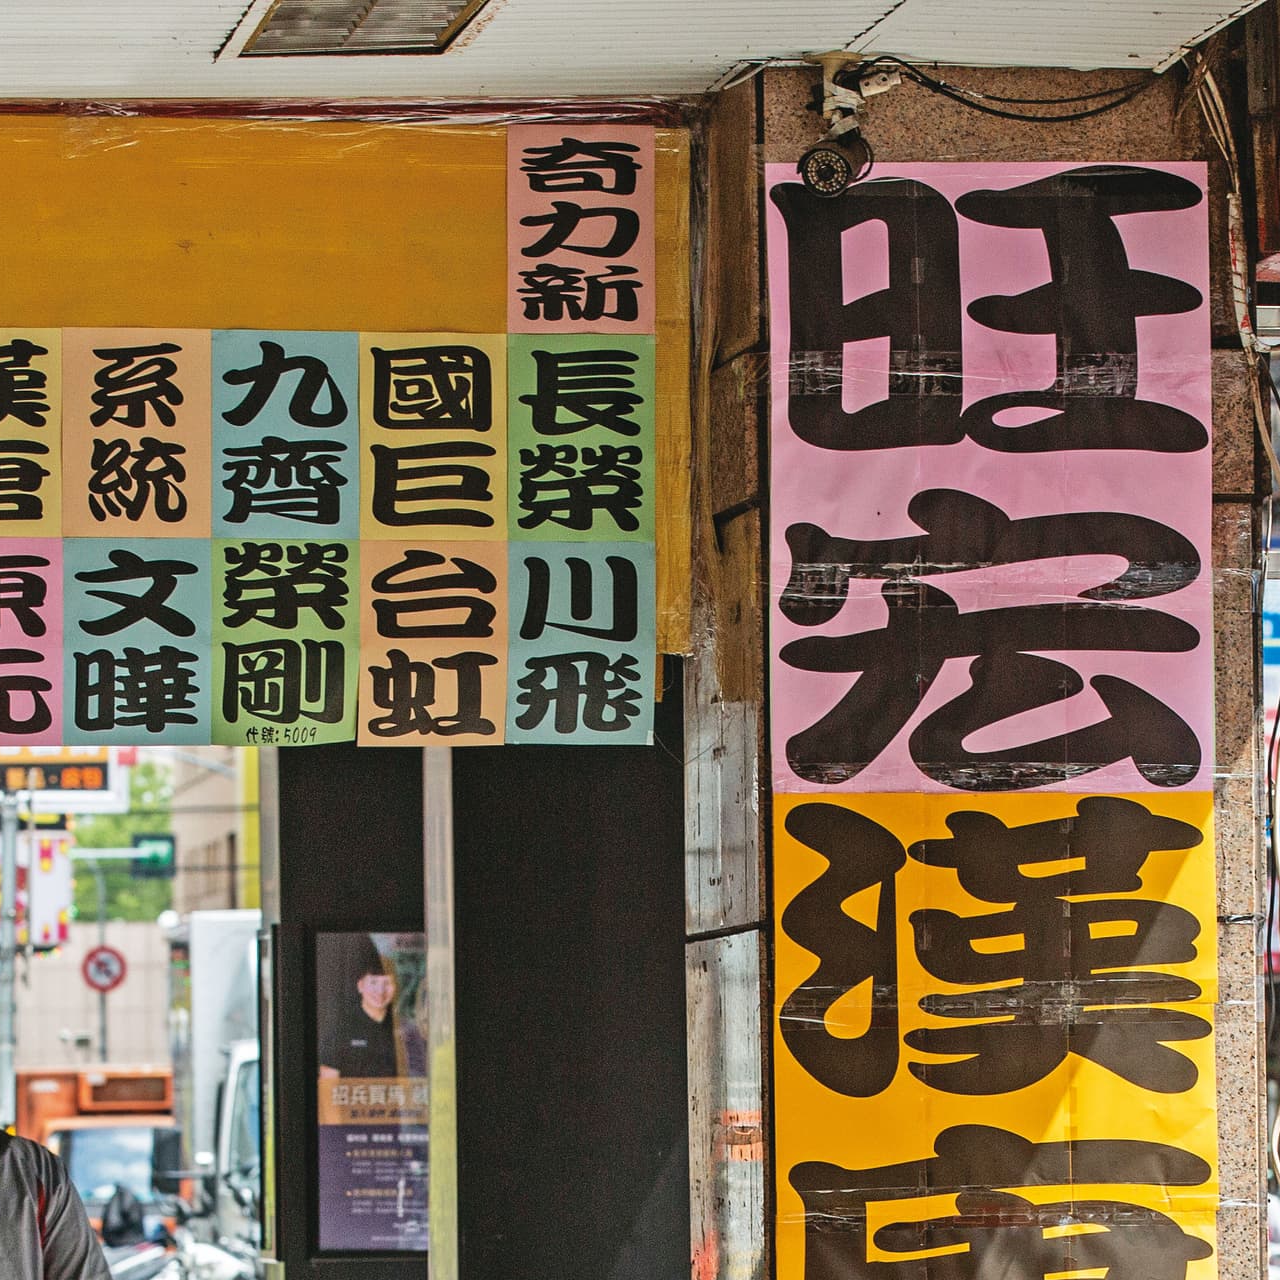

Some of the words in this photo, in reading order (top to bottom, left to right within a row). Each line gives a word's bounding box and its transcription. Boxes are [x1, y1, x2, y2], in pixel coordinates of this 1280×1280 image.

[516, 137, 644, 322] 奇力新
[87, 342, 188, 523] 系統
[221, 340, 349, 525] 九齊
[369, 344, 497, 528] 國巨
[516, 349, 645, 533] 長榮
[769, 164, 1210, 791] 旺宏
[72, 549, 201, 733] 文曄
[221, 542, 350, 725] 榮剛
[367, 549, 499, 738] 台虹
[515, 555, 643, 734] 川飛
